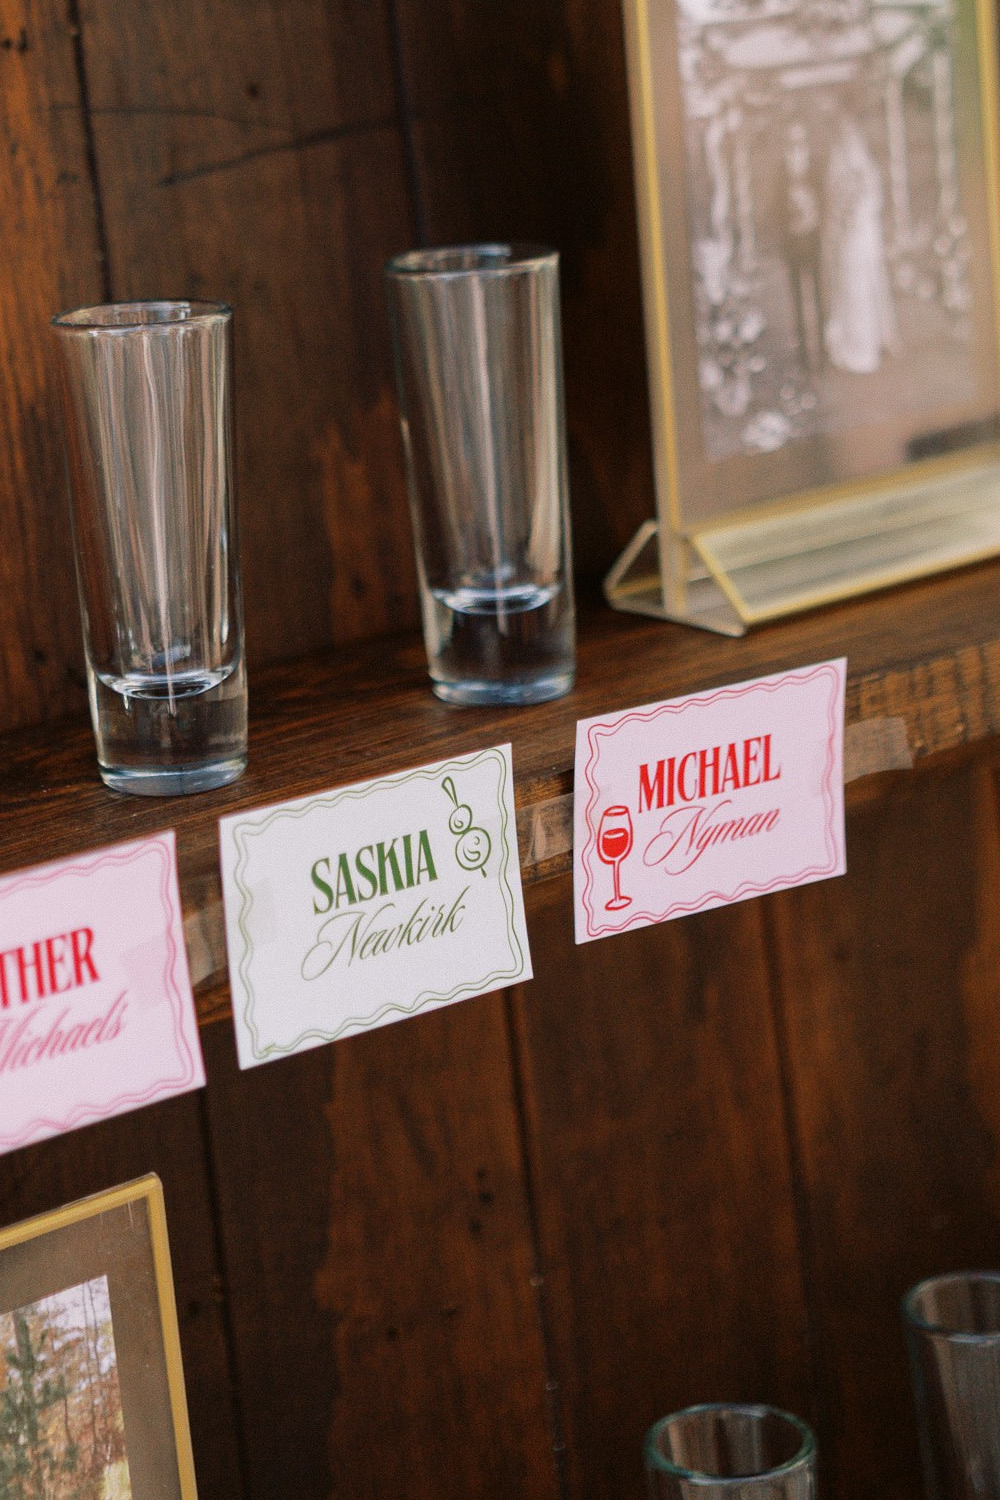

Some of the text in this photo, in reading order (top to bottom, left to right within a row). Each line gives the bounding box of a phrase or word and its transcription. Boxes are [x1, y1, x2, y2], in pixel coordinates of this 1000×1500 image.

[637, 733, 782, 814] MICHAEL
[310, 829, 439, 916] SASKIA
[642, 799, 781, 876] Nyman
[300, 885, 471, 982] Newkirk
